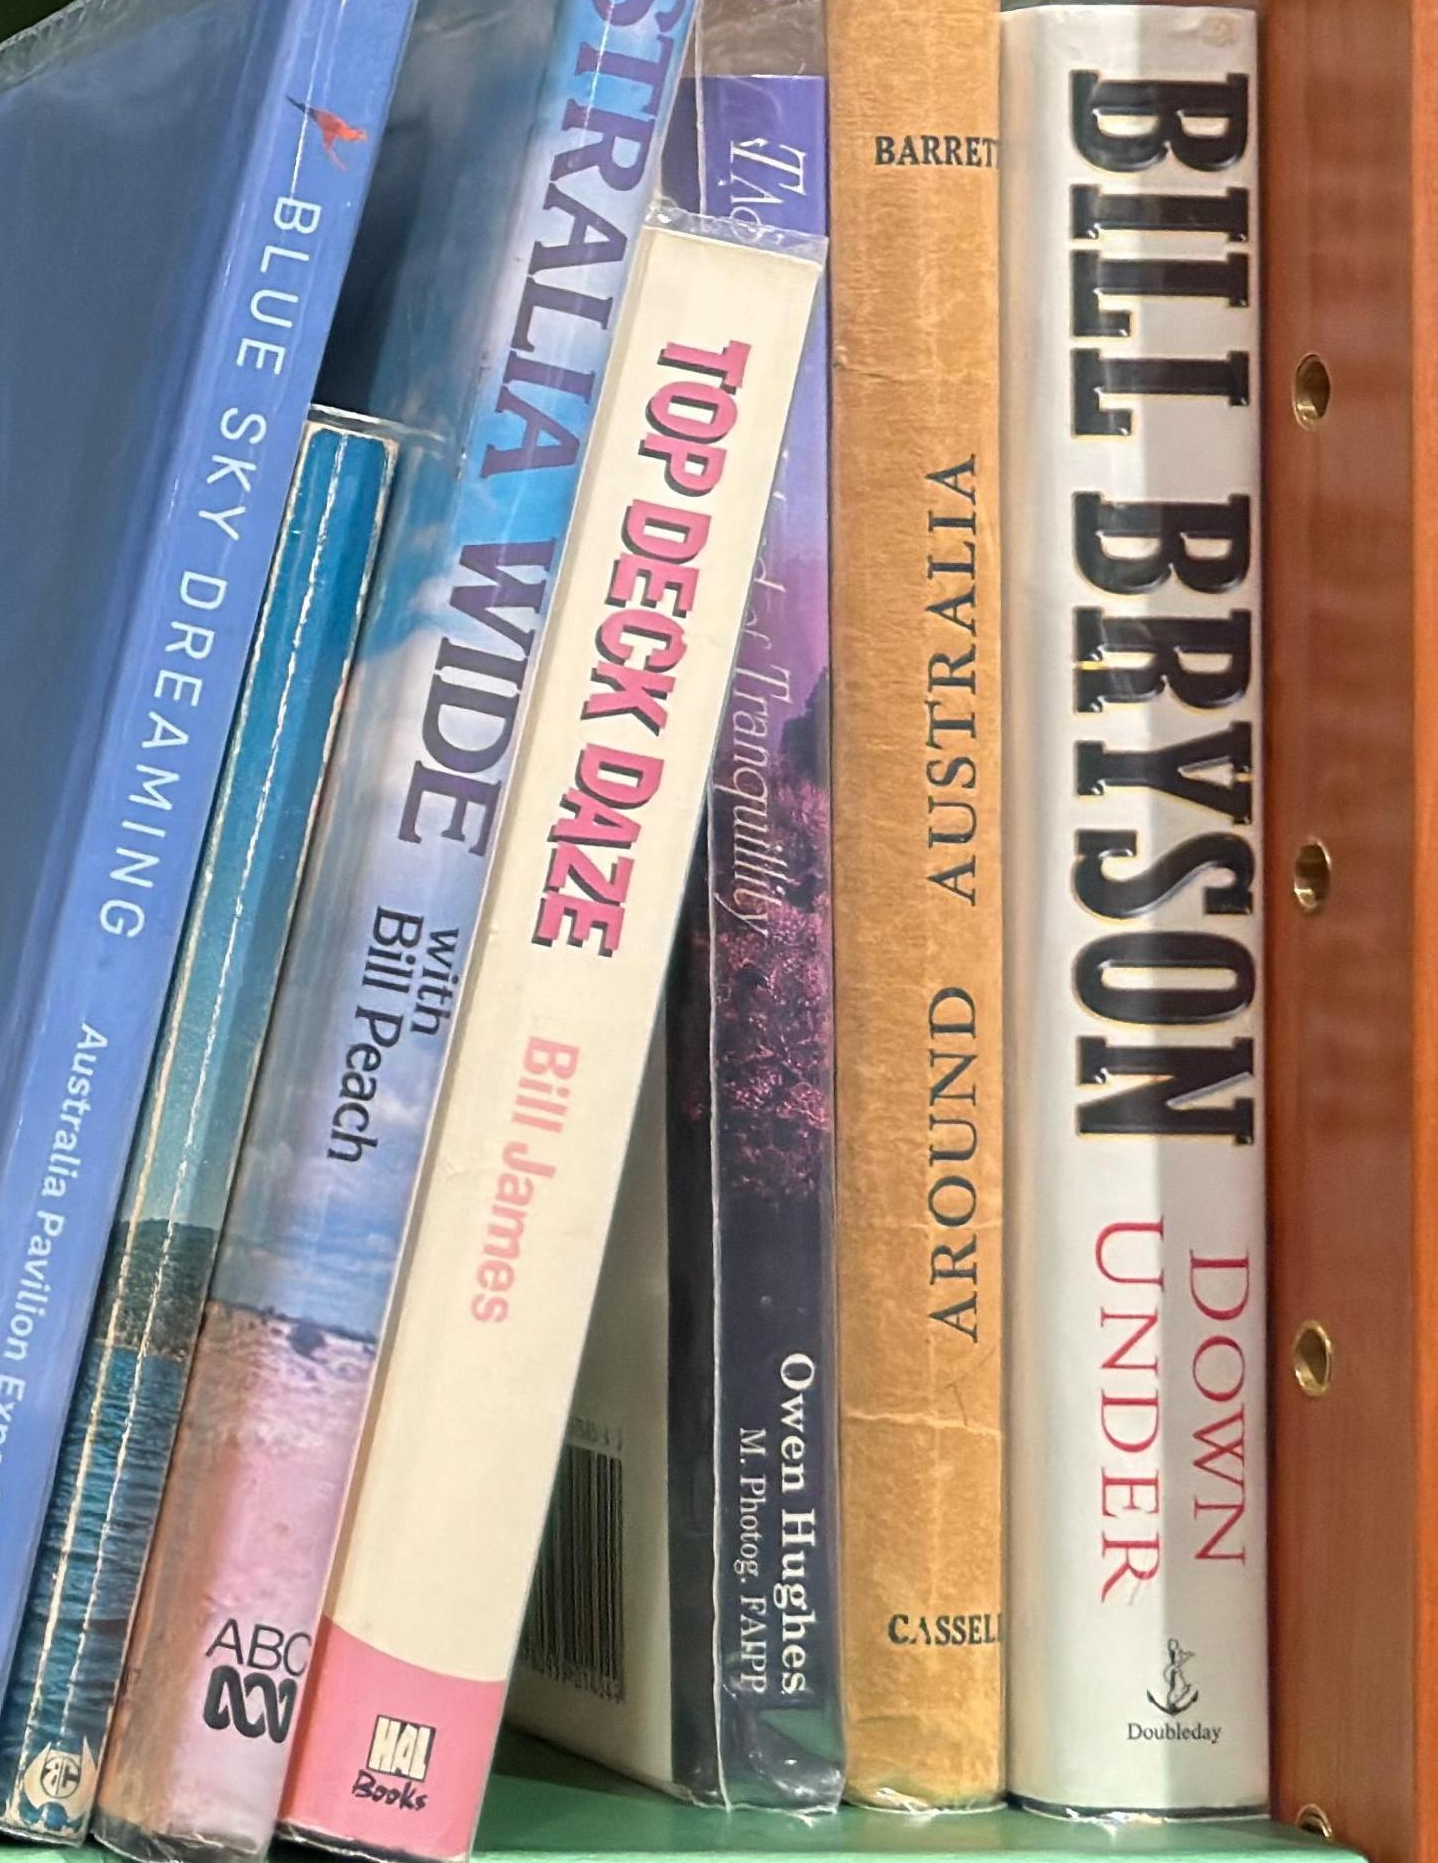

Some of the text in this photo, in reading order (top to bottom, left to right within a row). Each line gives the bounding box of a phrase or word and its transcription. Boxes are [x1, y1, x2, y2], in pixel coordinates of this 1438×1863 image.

[97, 193, 323, 939] BLUE SKY DREAMING
[399, 538, 556, 858] WIDE
[531, 339, 754, 959] TOP DECK DAZE
[1069, 68, 1257, 1147] BILL BRYSON
[326, 904, 426, 1164] Bill Peach
[408, 925, 462, 1036] with
[926, 453, 980, 1343] AROUND AUSTRALIA
[40, 1022, 109, 1199] Australia
[470, 1034, 581, 1325] Bill James
[1, 1208, 66, 1362] Pavilion
[1094, 1216, 1166, 1605] UNDER
[1189, 1248, 1251, 1568] DOWN
[734, 1427, 767, 1584] M. Photog.
[773, 1352, 817, 1695] Owen Hughes
[204, 1617, 313, 1675] ABC
[367, 1714, 436, 1782] HAL
[1127, 1720, 1222, 1744] Doubleday
[352, 1768, 429, 1812] Books
